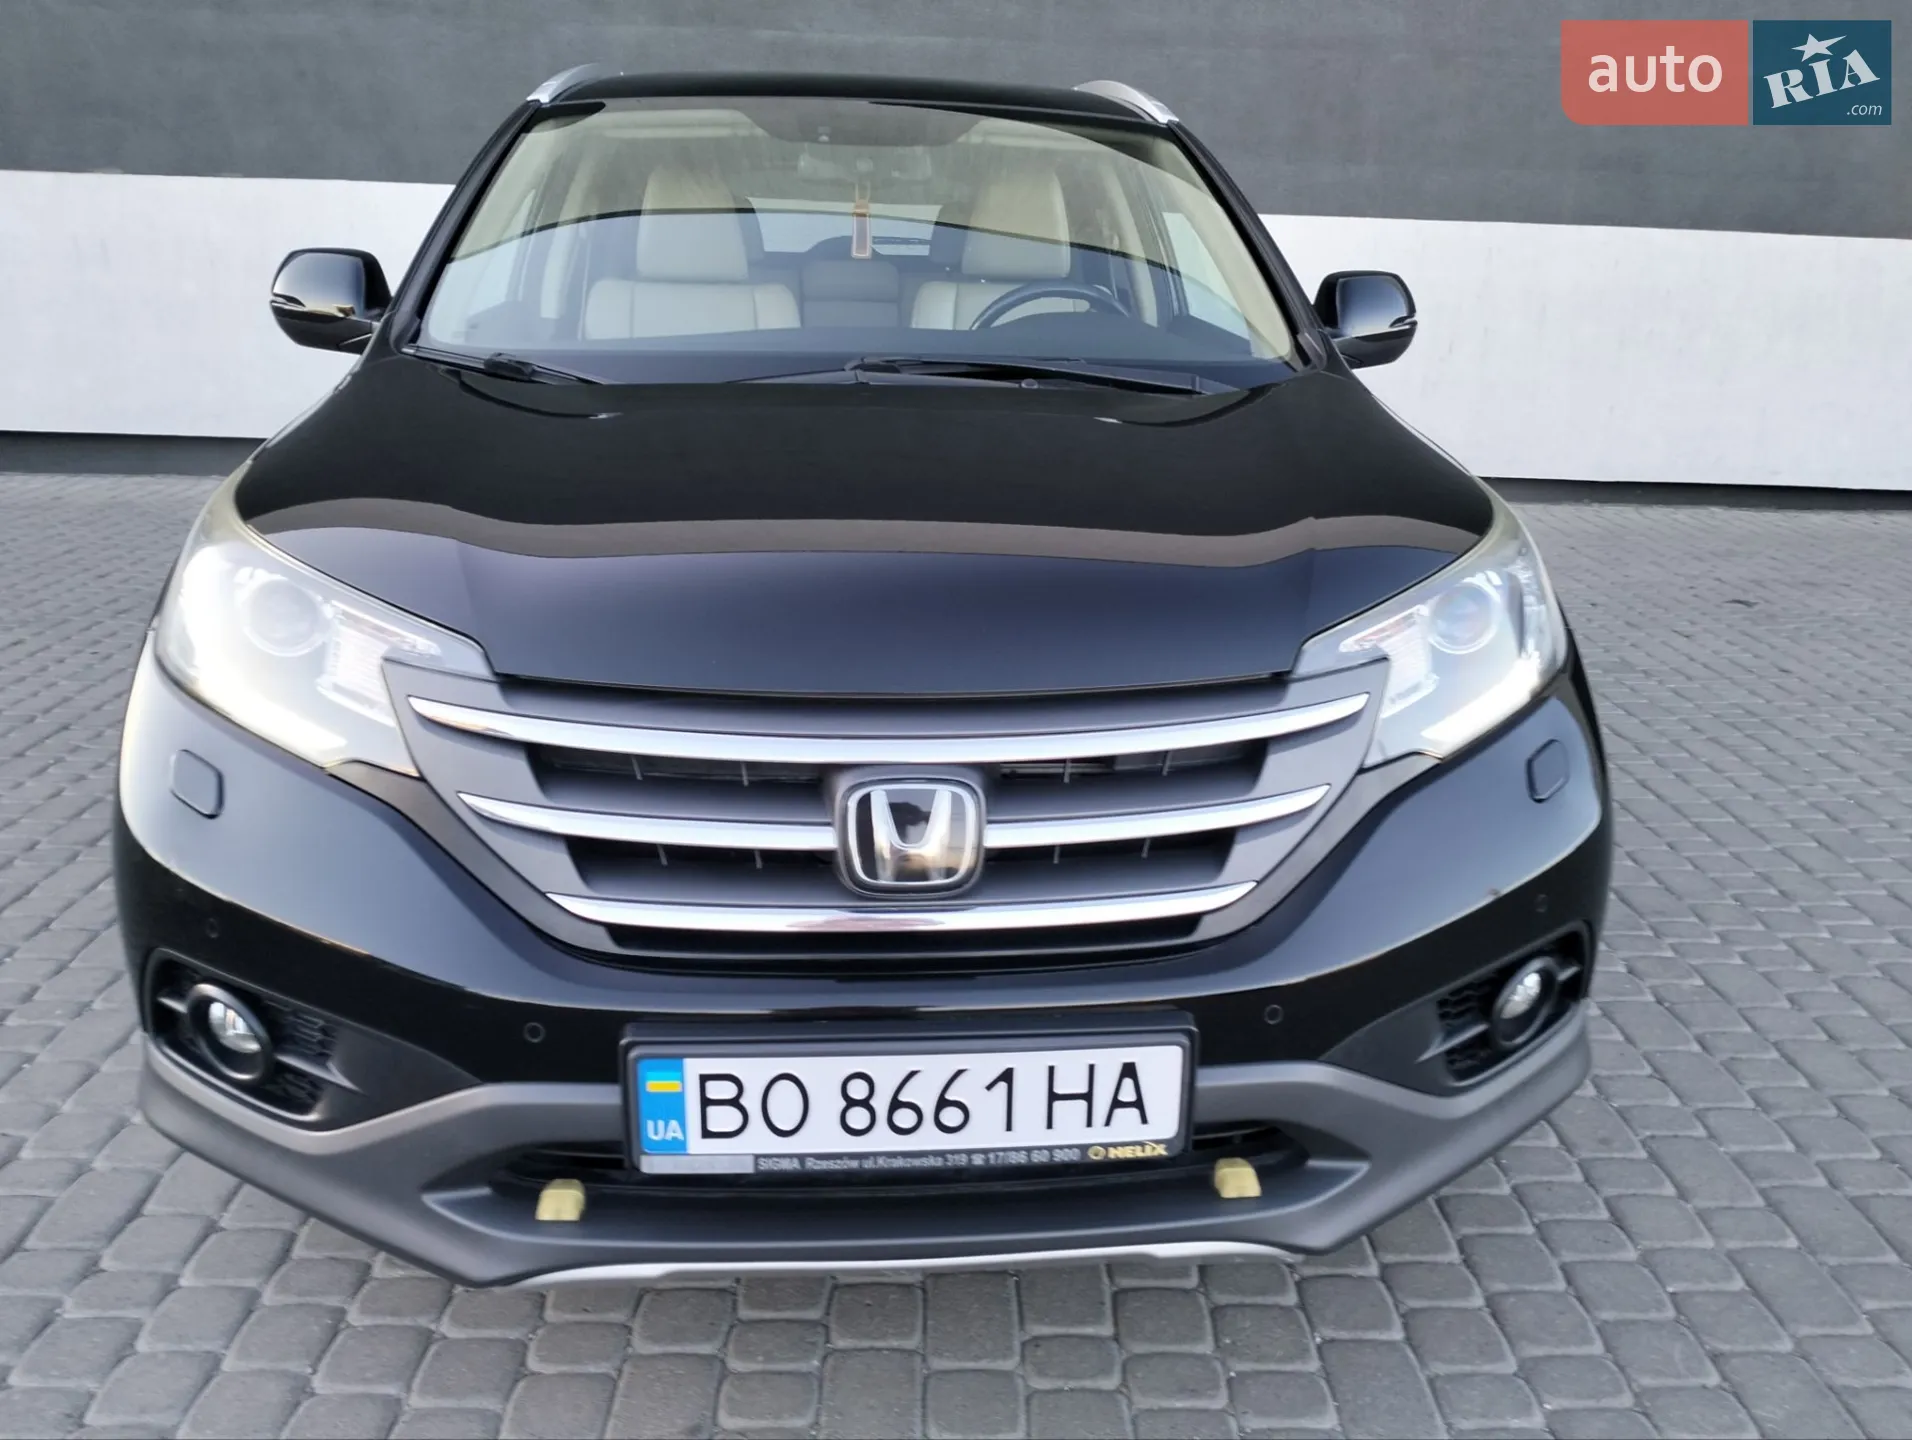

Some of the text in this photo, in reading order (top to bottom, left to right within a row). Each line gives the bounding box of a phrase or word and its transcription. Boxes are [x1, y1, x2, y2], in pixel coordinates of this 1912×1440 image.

[698, 1061, 1149, 1139] BO 8661 HA
[646, 1119, 685, 1141] UA
